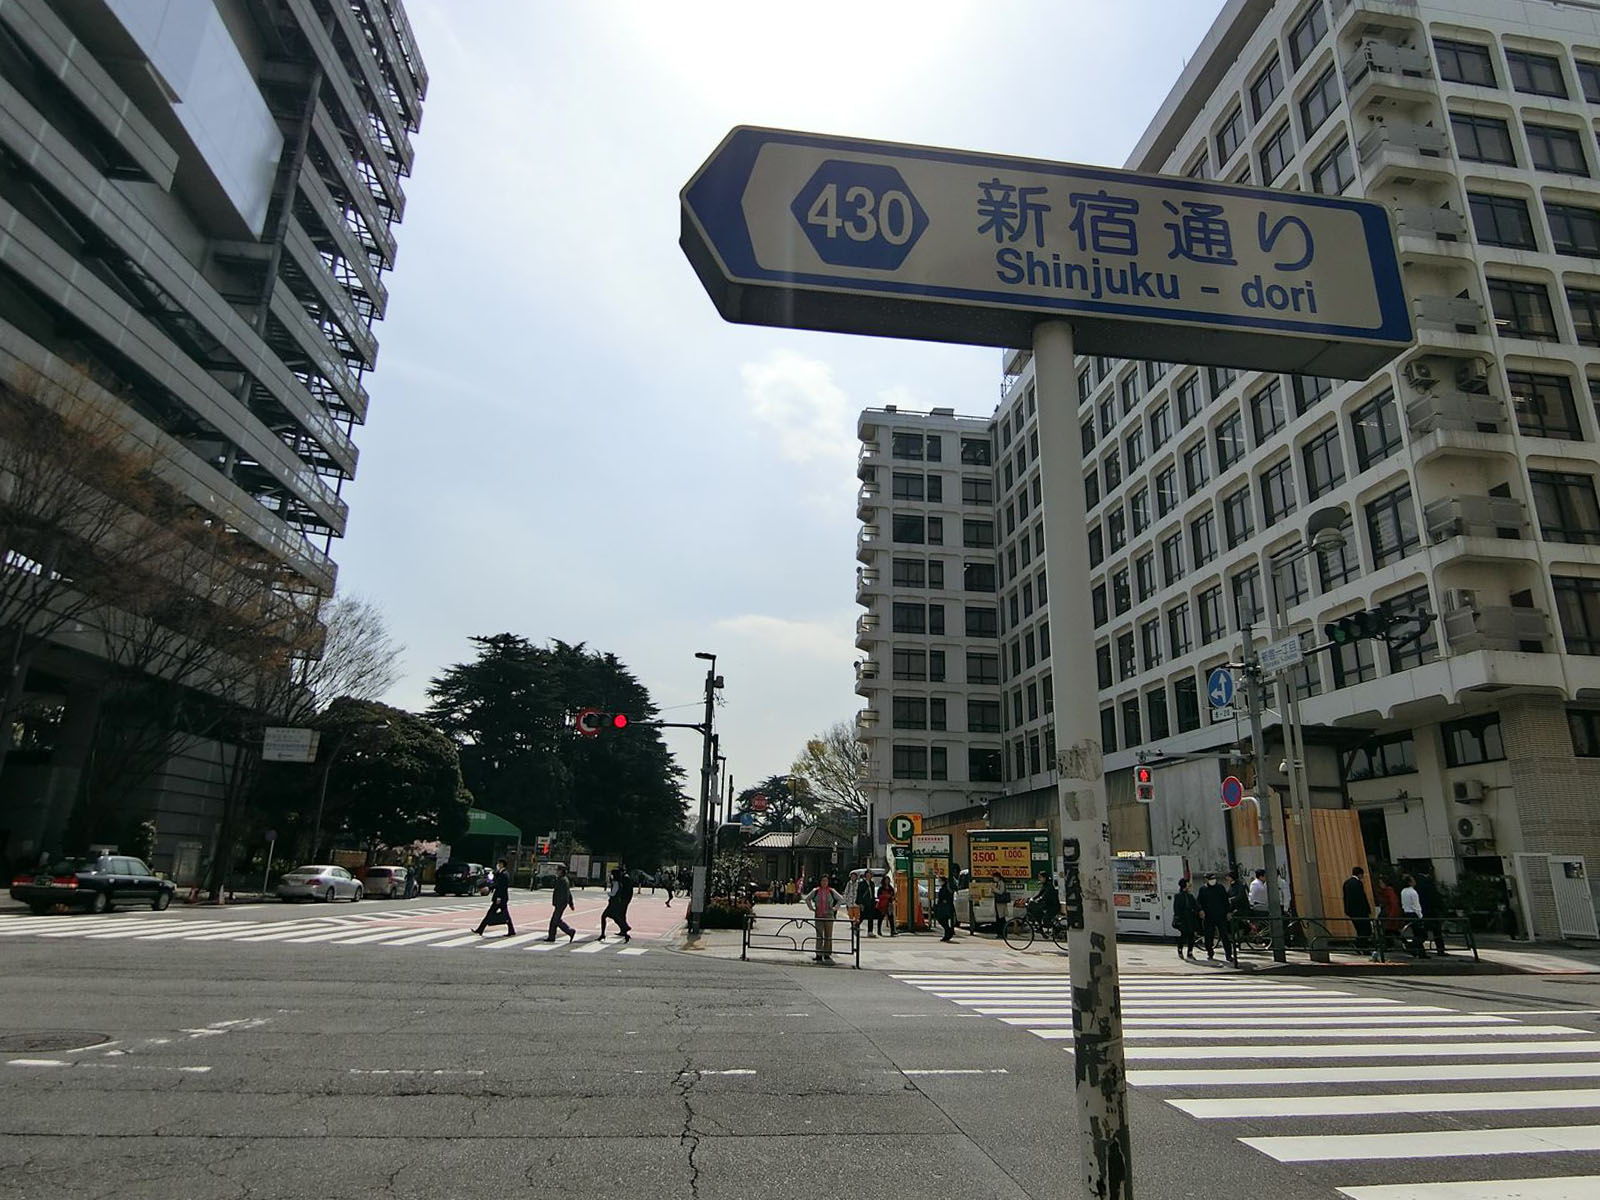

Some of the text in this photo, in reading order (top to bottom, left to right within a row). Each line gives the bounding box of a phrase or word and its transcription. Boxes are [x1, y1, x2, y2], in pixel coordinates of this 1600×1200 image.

[807, 183, 913, 245] 430
[977, 177, 1314, 271] 新宿通り
[996, 248, 1180, 299] Shinjuku
[1241, 275, 1317, 313] dori
[897, 819, 911, 838] P
